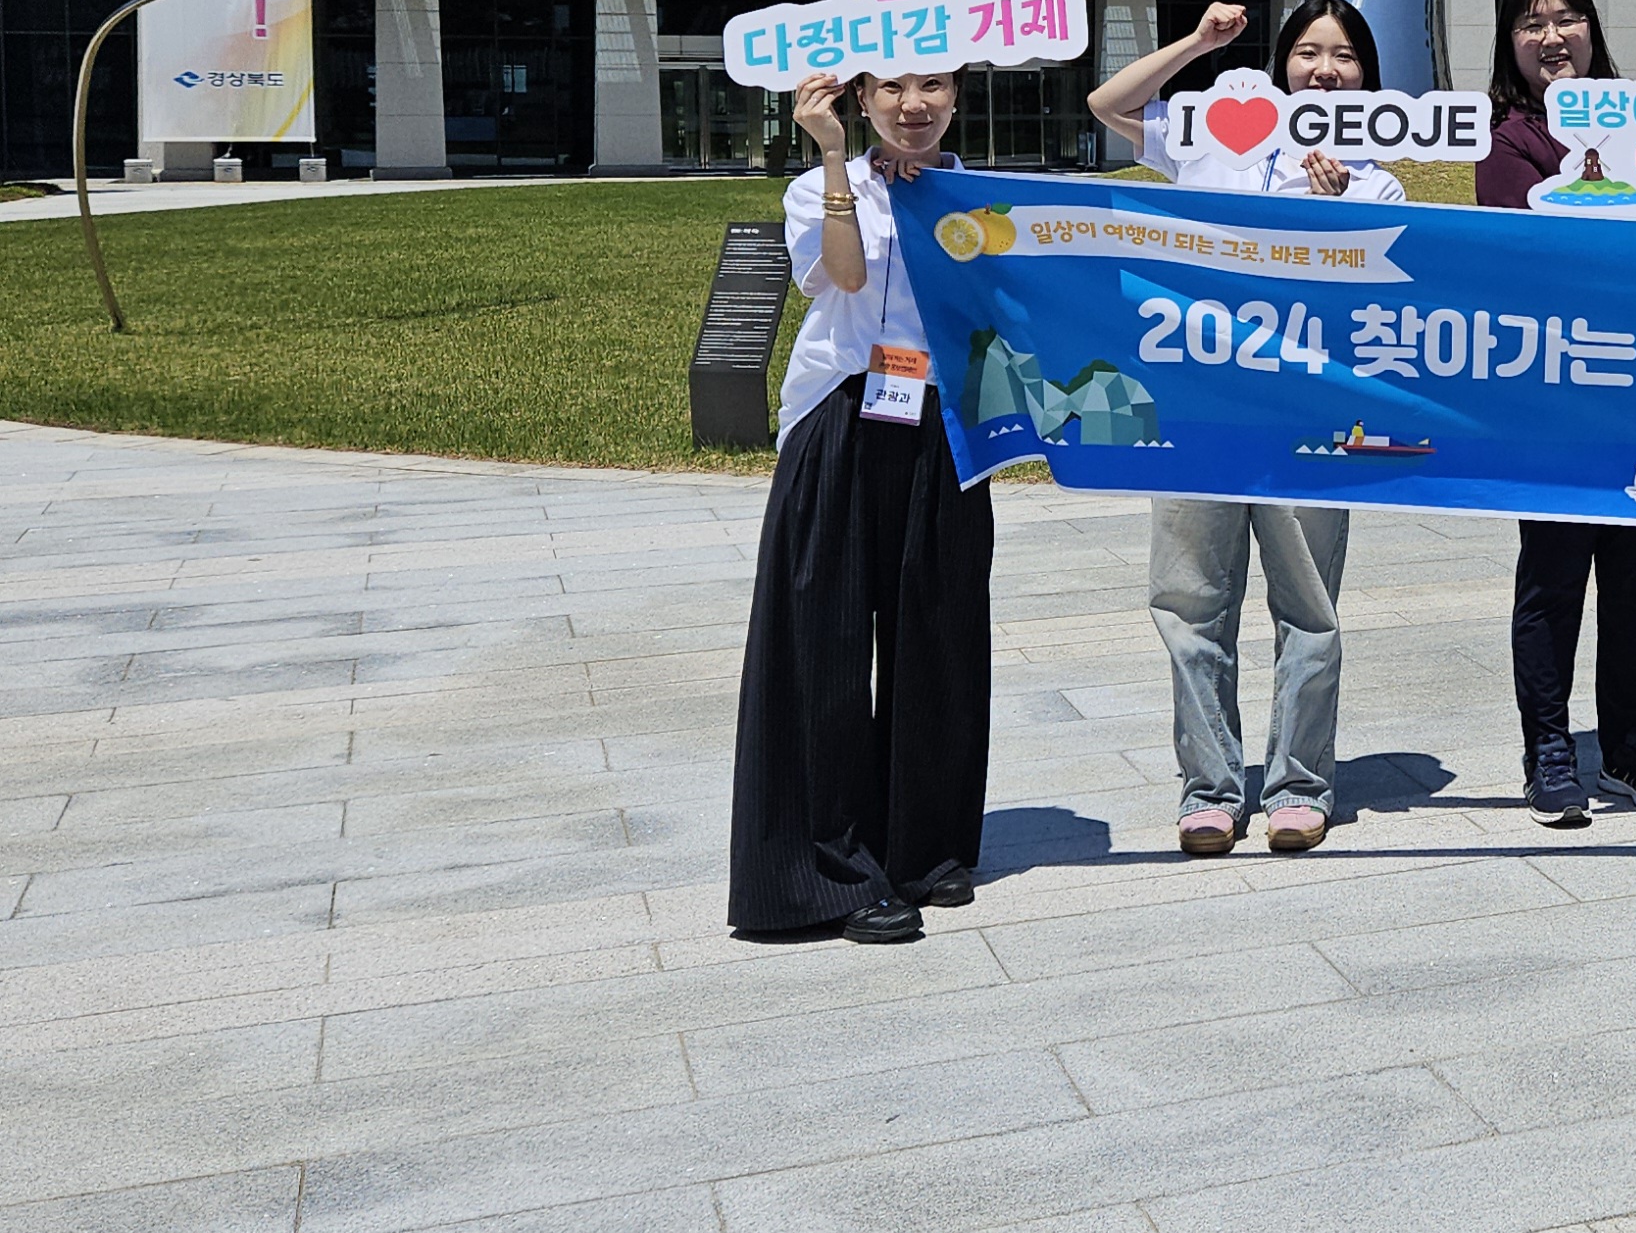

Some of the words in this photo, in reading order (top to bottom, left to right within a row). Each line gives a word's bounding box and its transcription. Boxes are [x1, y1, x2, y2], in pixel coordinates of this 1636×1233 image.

[743, 4, 951, 73] 다정다감
[207, 70, 285, 88] 경상북도
[1179, 105, 1195, 147] I
[1288, 102, 1478, 148] GEOJE
[1030, 220, 1097, 245] 일상이
[1103, 224, 1169, 248] 여행이
[1173, 232, 1215, 254] 되는
[1220, 240, 1265, 264] 그곳,
[1270, 245, 1311, 266] 바로
[1319, 247, 1366, 269] 거제!
[1138, 297, 1330, 374] 2024
